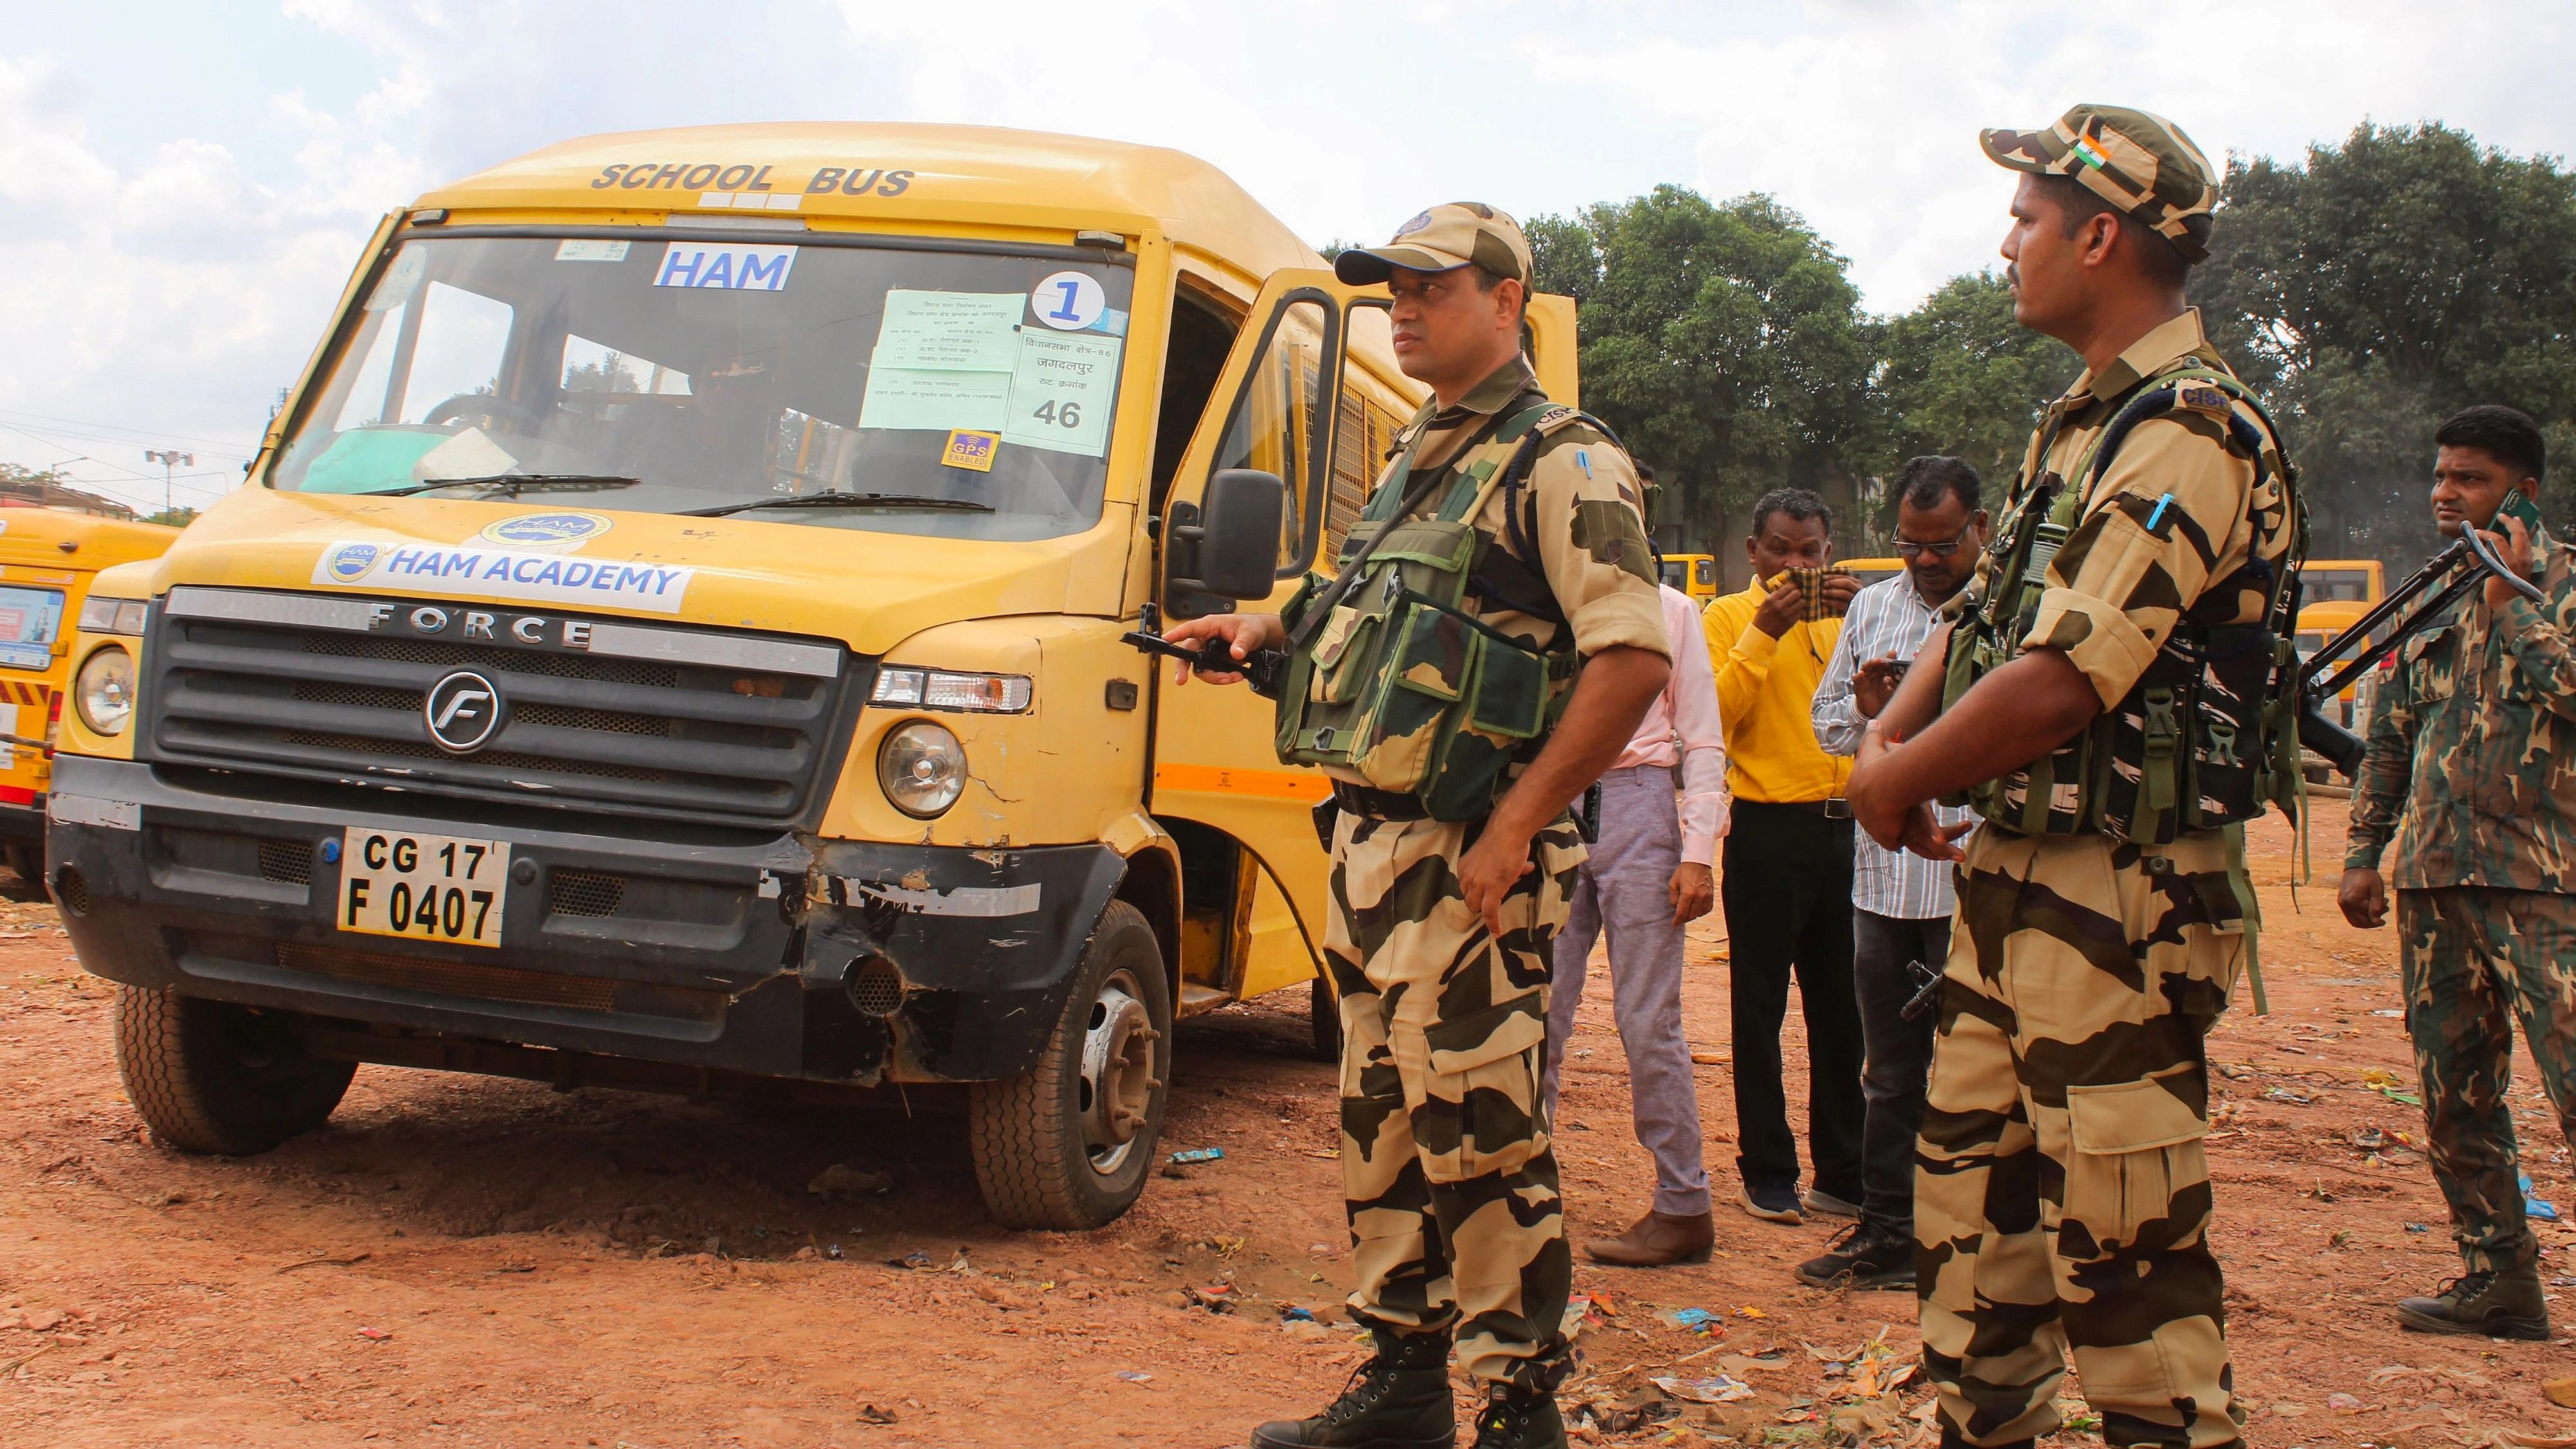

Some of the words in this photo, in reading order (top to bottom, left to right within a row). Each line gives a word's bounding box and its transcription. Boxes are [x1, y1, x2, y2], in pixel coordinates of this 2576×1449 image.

[591, 163, 774, 191] SCHOOL
[804, 167, 915, 197] BUS
[660, 251, 788, 289] HAM
[1049, 281, 1080, 322] 1
[1025, 338, 1071, 352] विधानसभा
[1037, 357, 1095, 375] जगदलपुर
[1059, 379, 1088, 390] क्रमांक
[2181, 388, 2228, 407] CISF
[1033, 399, 1081, 429] 46
[949, 454, 985, 465] ENABLED
[953, 443, 987, 456] GPS
[518, 519, 592, 529] HAM
[388, 548, 482, 579] HAM
[482, 556, 681, 596] ACADEMY
[368, 603, 591, 649] FORCE
[364, 834, 418, 873] CG
[440, 842, 486, 880] 17
[348, 878, 370, 926] F
[390, 881, 494, 940] 0407
